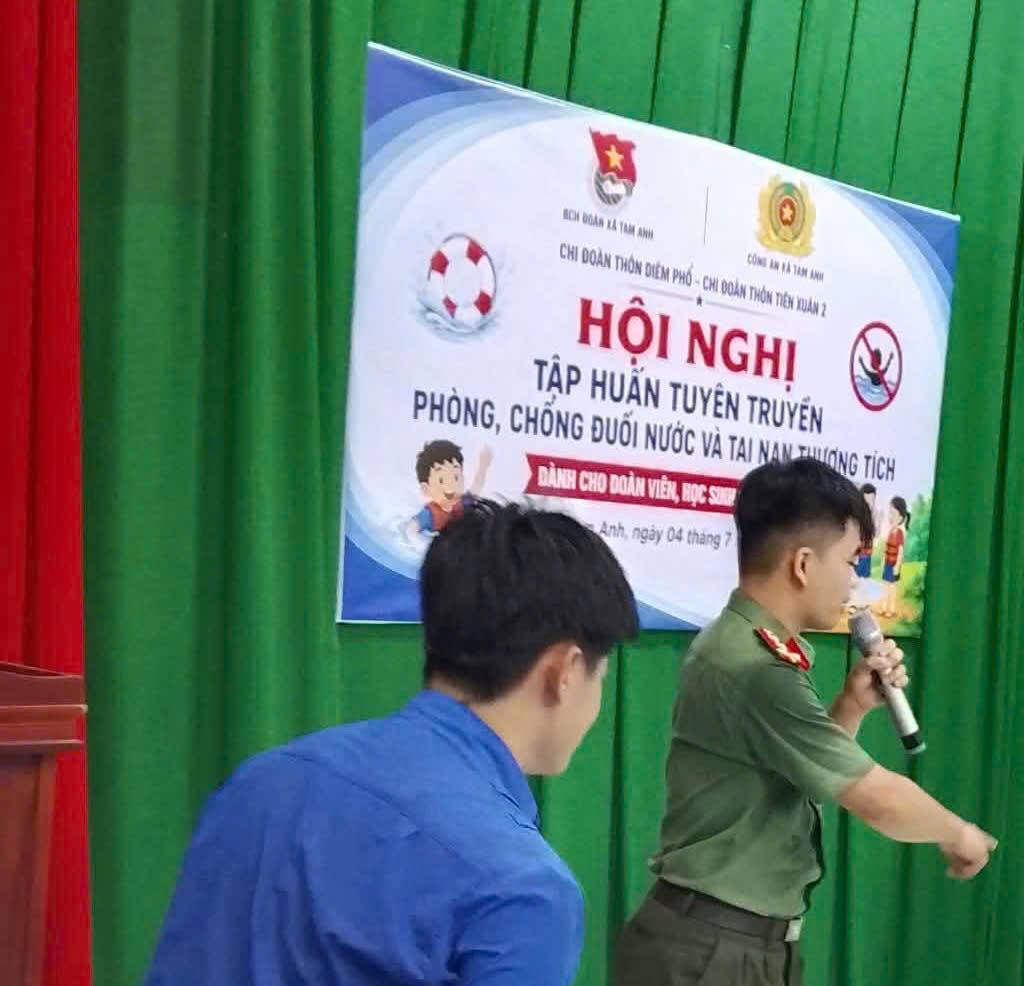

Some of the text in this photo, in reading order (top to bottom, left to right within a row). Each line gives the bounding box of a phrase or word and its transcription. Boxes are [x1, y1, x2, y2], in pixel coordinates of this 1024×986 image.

[637, 226, 654, 240] ANH
[559, 242, 578, 262] CHI
[582, 245, 611, 269] ĐOÀN
[615, 253, 642, 276] THÔN
[703, 275, 718, 293] CHI
[721, 276, 746, 299] ĐOÀN
[749, 284, 772, 305] THÔN
[776, 290, 794, 311] TIÊN
[797, 295, 819, 316] XUÂN
[820, 302, 827, 318] 2
[770, 259, 780, 271] AN
[810, 268, 824, 282] ANH
[577, 296, 797, 392] HỘI NGHỊ
[534, 354, 581, 399] TẬP
[591, 366, 661, 409] HUẤN
[669, 382, 740, 421] TUYÊN
[413, 387, 501, 435] PHÒNG,
[510, 396, 584, 440] CHỐNG
[591, 409, 638, 449] ĐUỐI
[644, 420, 696, 456] NƯỚC
[701, 426, 722, 460] VÀ
[729, 435, 751, 463] TAI
[864, 449, 896, 482] TÍCH
[537, 461, 577, 490] DÀNH
[579, 470, 608, 495] CHO
[609, 470, 646, 499] ĐOÀN
[647, 474, 680, 505] VIÊN,
[682, 482, 708, 508] HỌC
[600, 521, 629, 540] Anh,
[632, 524, 664, 545] ngày
[667, 526, 683, 544] 04
[687, 528, 720, 550] tháng
[724, 531, 732, 548] 7
